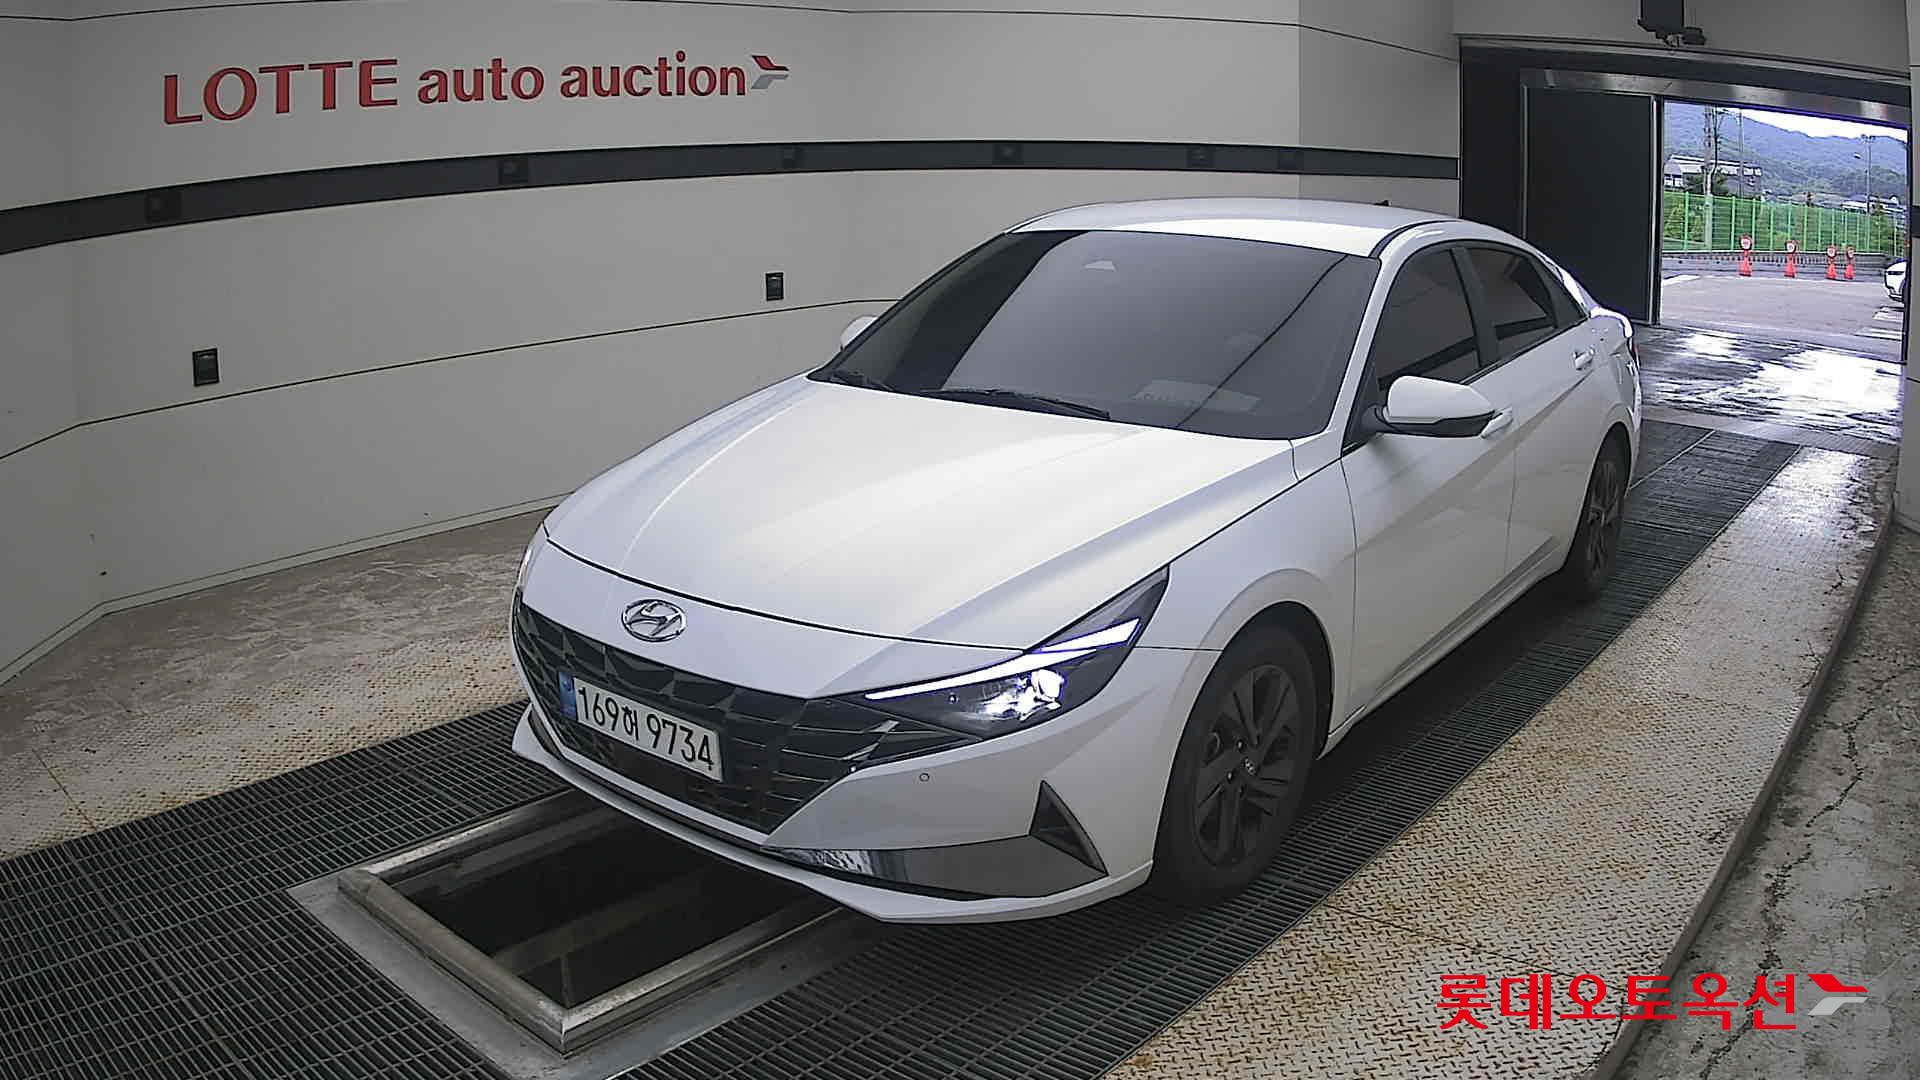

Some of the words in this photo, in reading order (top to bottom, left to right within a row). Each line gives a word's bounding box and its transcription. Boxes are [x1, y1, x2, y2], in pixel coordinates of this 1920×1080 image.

[164, 59, 398, 125] LOTTE
[418, 58, 545, 104] auto
[560, 50, 747, 98] auction
[577, 686, 640, 741] 169허
[646, 713, 716, 771] 9734
